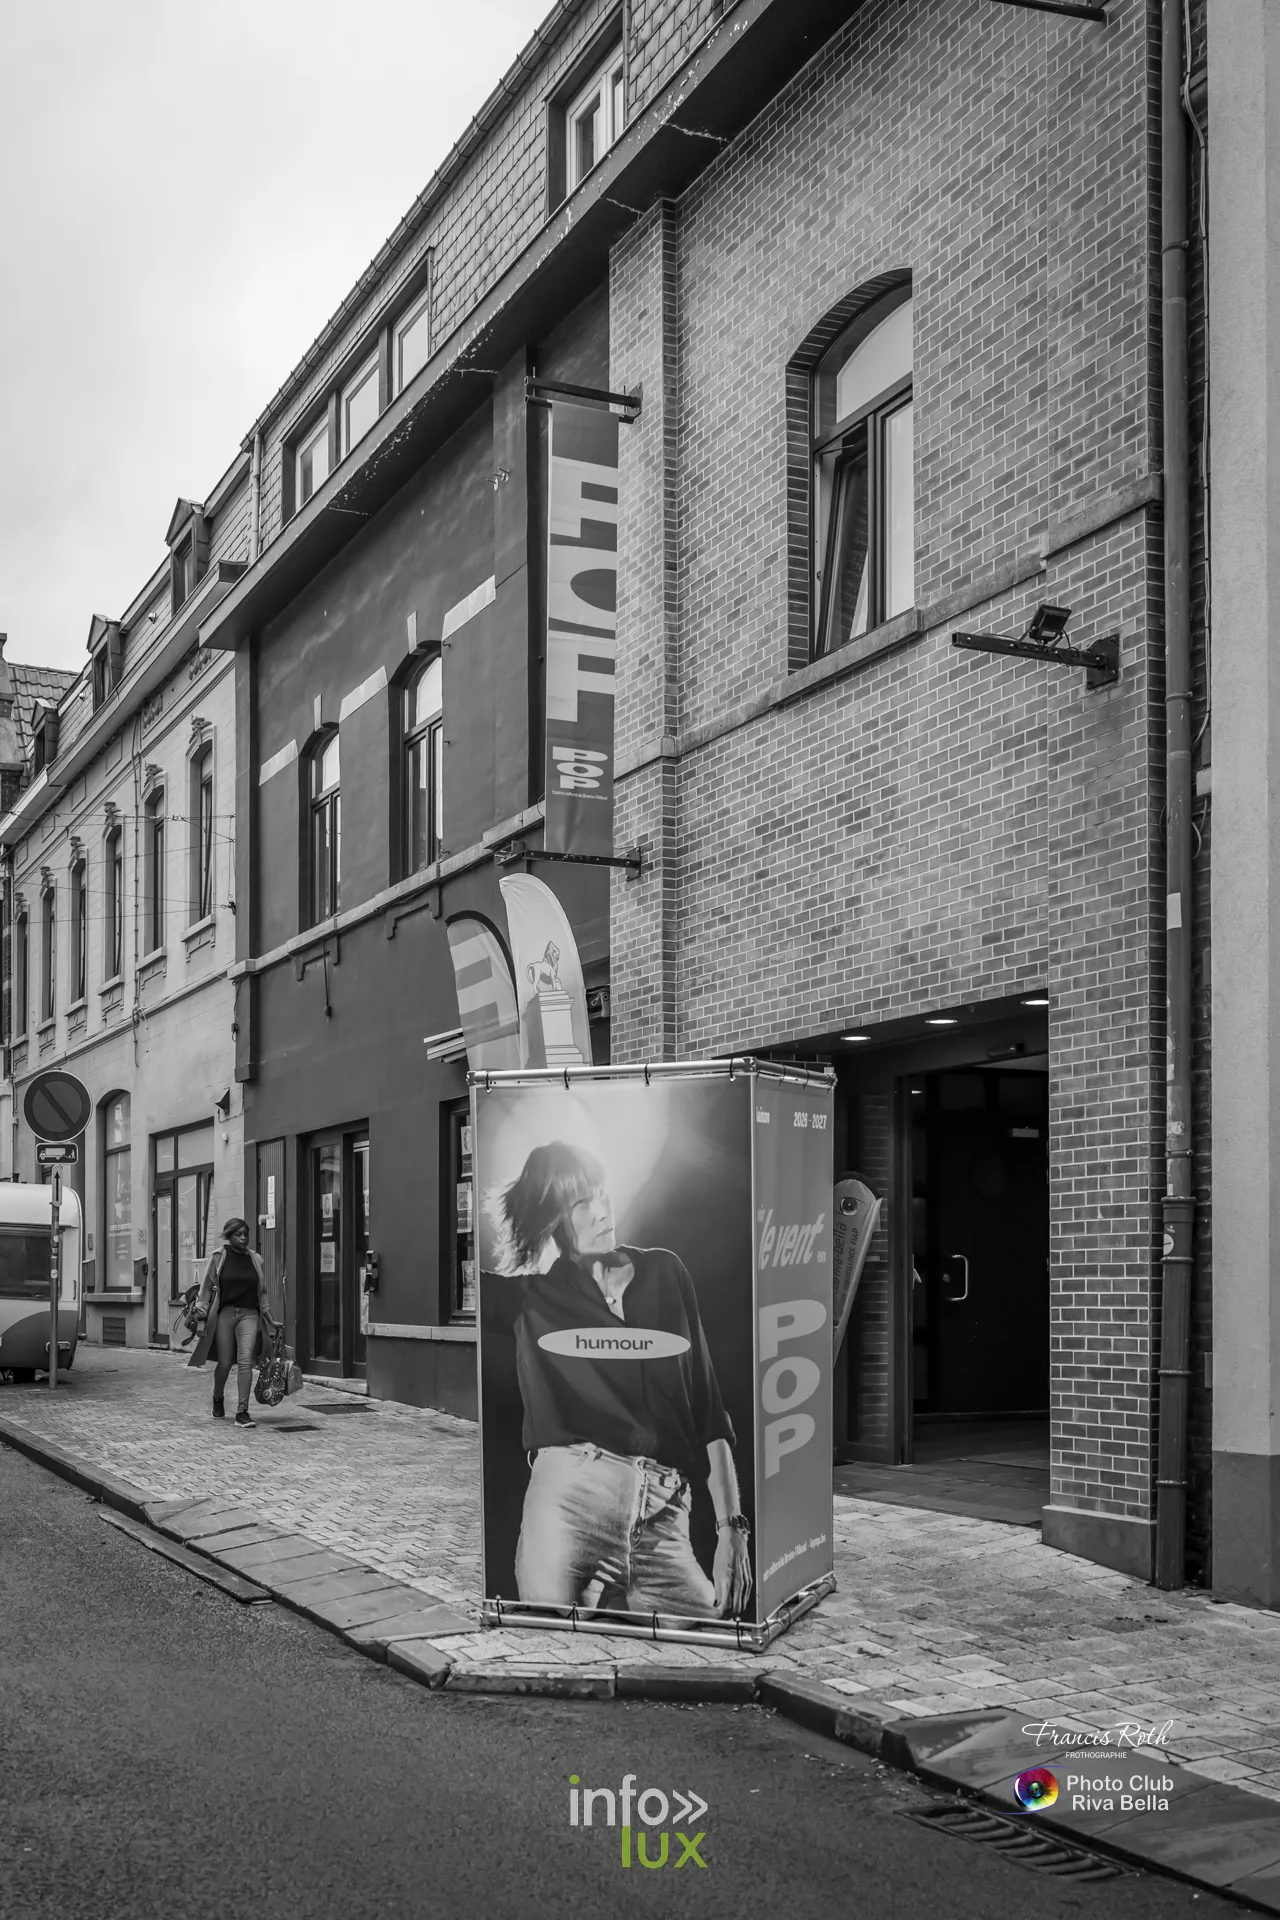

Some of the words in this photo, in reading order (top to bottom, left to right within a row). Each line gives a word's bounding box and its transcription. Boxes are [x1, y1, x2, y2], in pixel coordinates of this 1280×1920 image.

[552, 746, 608, 789] POP
[772, 1212, 826, 1268] vent
[575, 1335, 654, 1351] humour
[758, 1299, 827, 1480] POP
